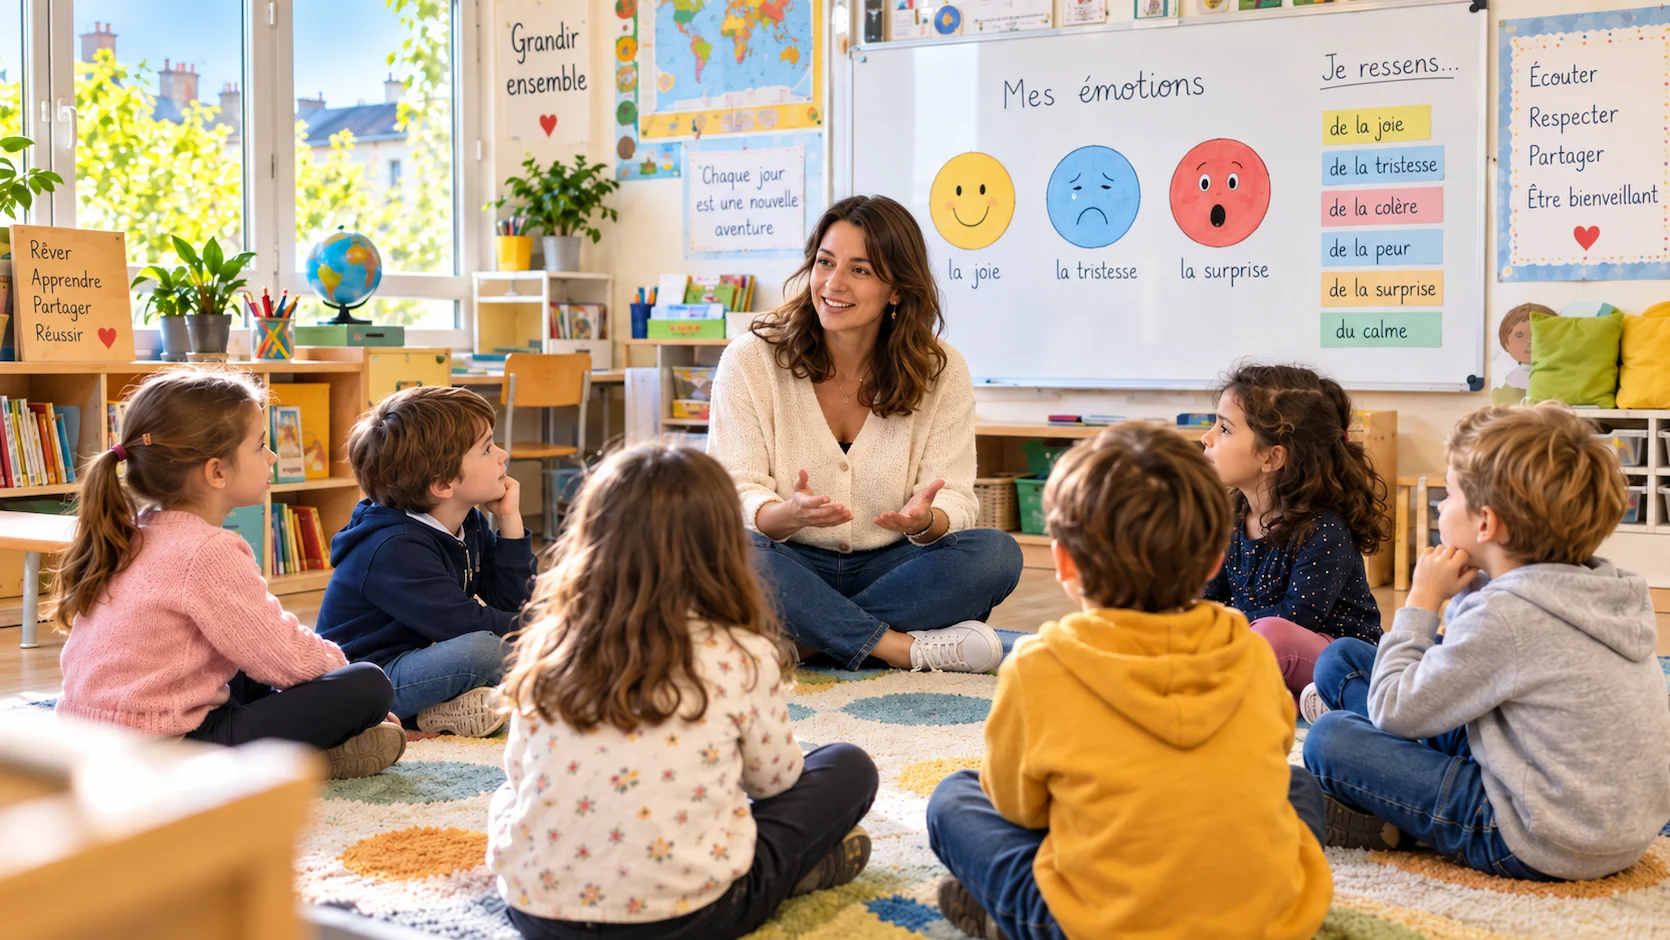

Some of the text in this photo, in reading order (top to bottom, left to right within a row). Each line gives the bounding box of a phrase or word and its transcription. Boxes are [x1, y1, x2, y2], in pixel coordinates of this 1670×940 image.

[511, 22, 580, 64] Grandir
[506, 64, 588, 95] ensemble
[1321, 53, 1459, 81] Je ressens...
[1529, 61, 1598, 88] Écouter
[1003, 71, 1205, 109] Mes émotions
[1329, 115, 1405, 141] de la joie
[1529, 104, 1619, 134] Respecter
[1329, 156, 1438, 176] de la tristesse
[1529, 145, 1605, 172] Partager
[702, 165, 786, 190] Chaque jour
[696, 190, 799, 212] est une nouvelle
[1329, 196, 1418, 217] de la colère
[1528, 183, 1659, 209] Être bienveillant
[715, 218, 774, 237] aventure
[30, 240, 72, 260] Rêver
[1329, 237, 1411, 264] de la peur
[31, 268, 102, 294] Apprendre
[949, 258, 1001, 289] la joie
[1056, 259, 1138, 280] la tristesse
[1180, 258, 1270, 287] la surprise
[1329, 277, 1436, 304] de la surprise
[33, 296, 91, 322] Partager
[35, 323, 84, 342] Réussir
[1336, 319, 1408, 339] du calme
